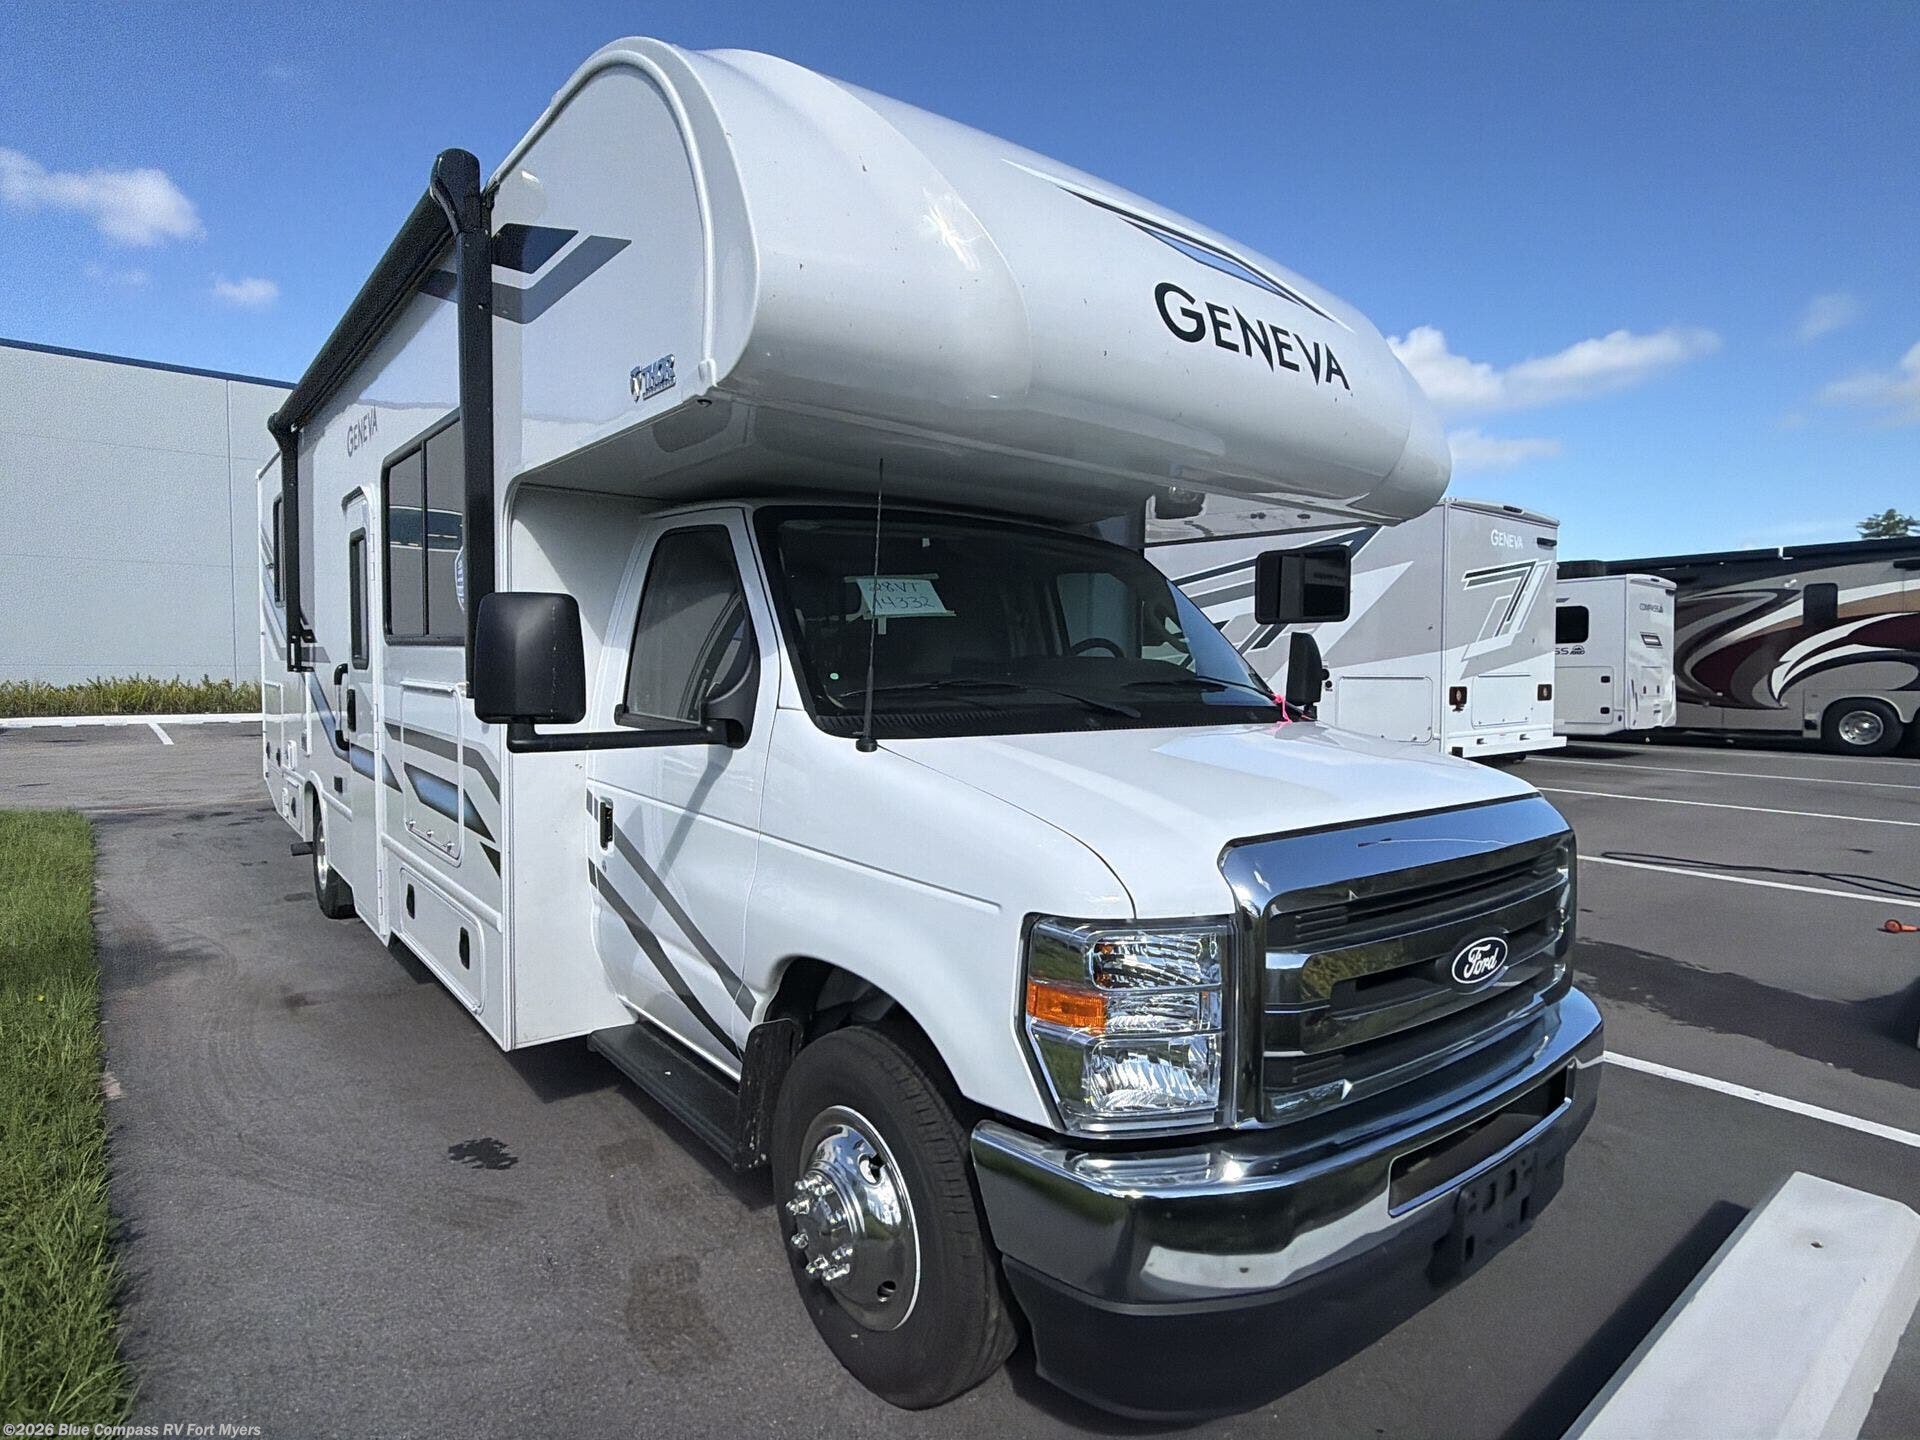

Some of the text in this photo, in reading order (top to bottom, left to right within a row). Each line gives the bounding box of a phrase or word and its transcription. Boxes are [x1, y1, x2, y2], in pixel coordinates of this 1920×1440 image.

[1154, 282, 1350, 391] GENEVA
[346, 405, 378, 458] GENEVA
[1490, 529, 1524, 549] GENEVA
[1463, 943, 1500, 979] Ford
